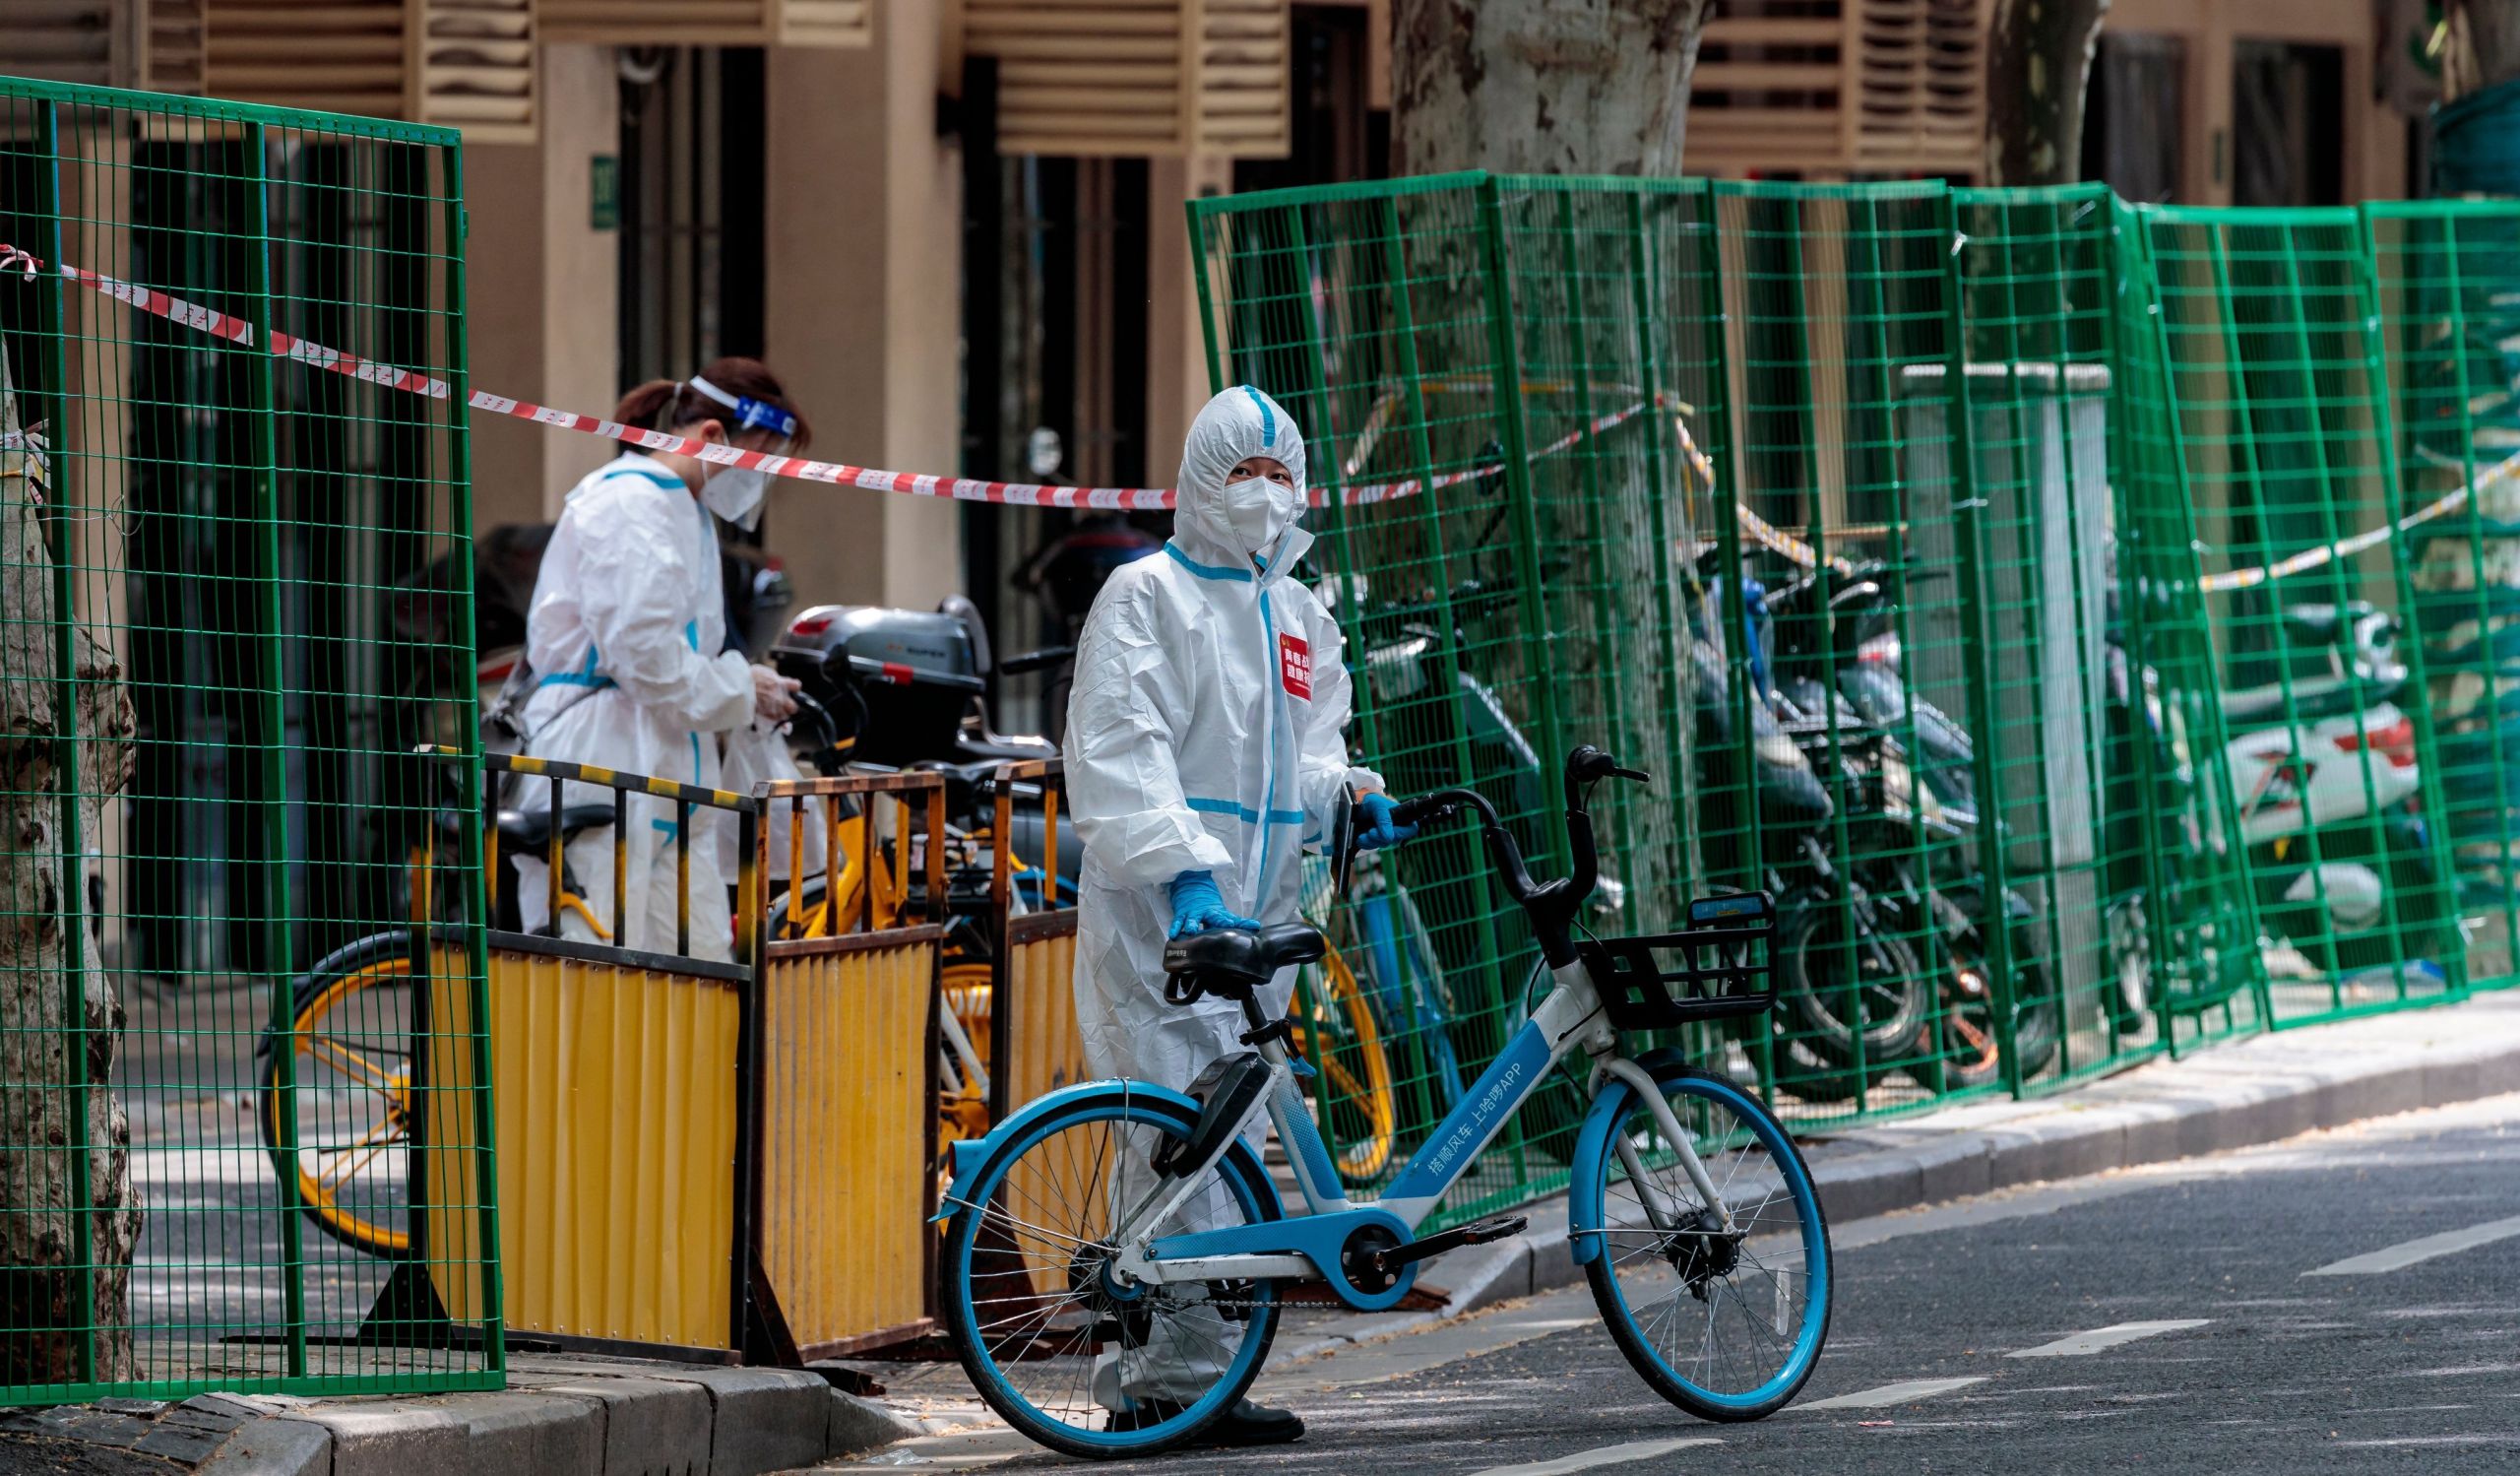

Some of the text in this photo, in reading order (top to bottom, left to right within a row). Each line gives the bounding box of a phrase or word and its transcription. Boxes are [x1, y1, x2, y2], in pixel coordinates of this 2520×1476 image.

[1427, 1062, 1522, 1176] 搭顺风车 上哈啰APP
